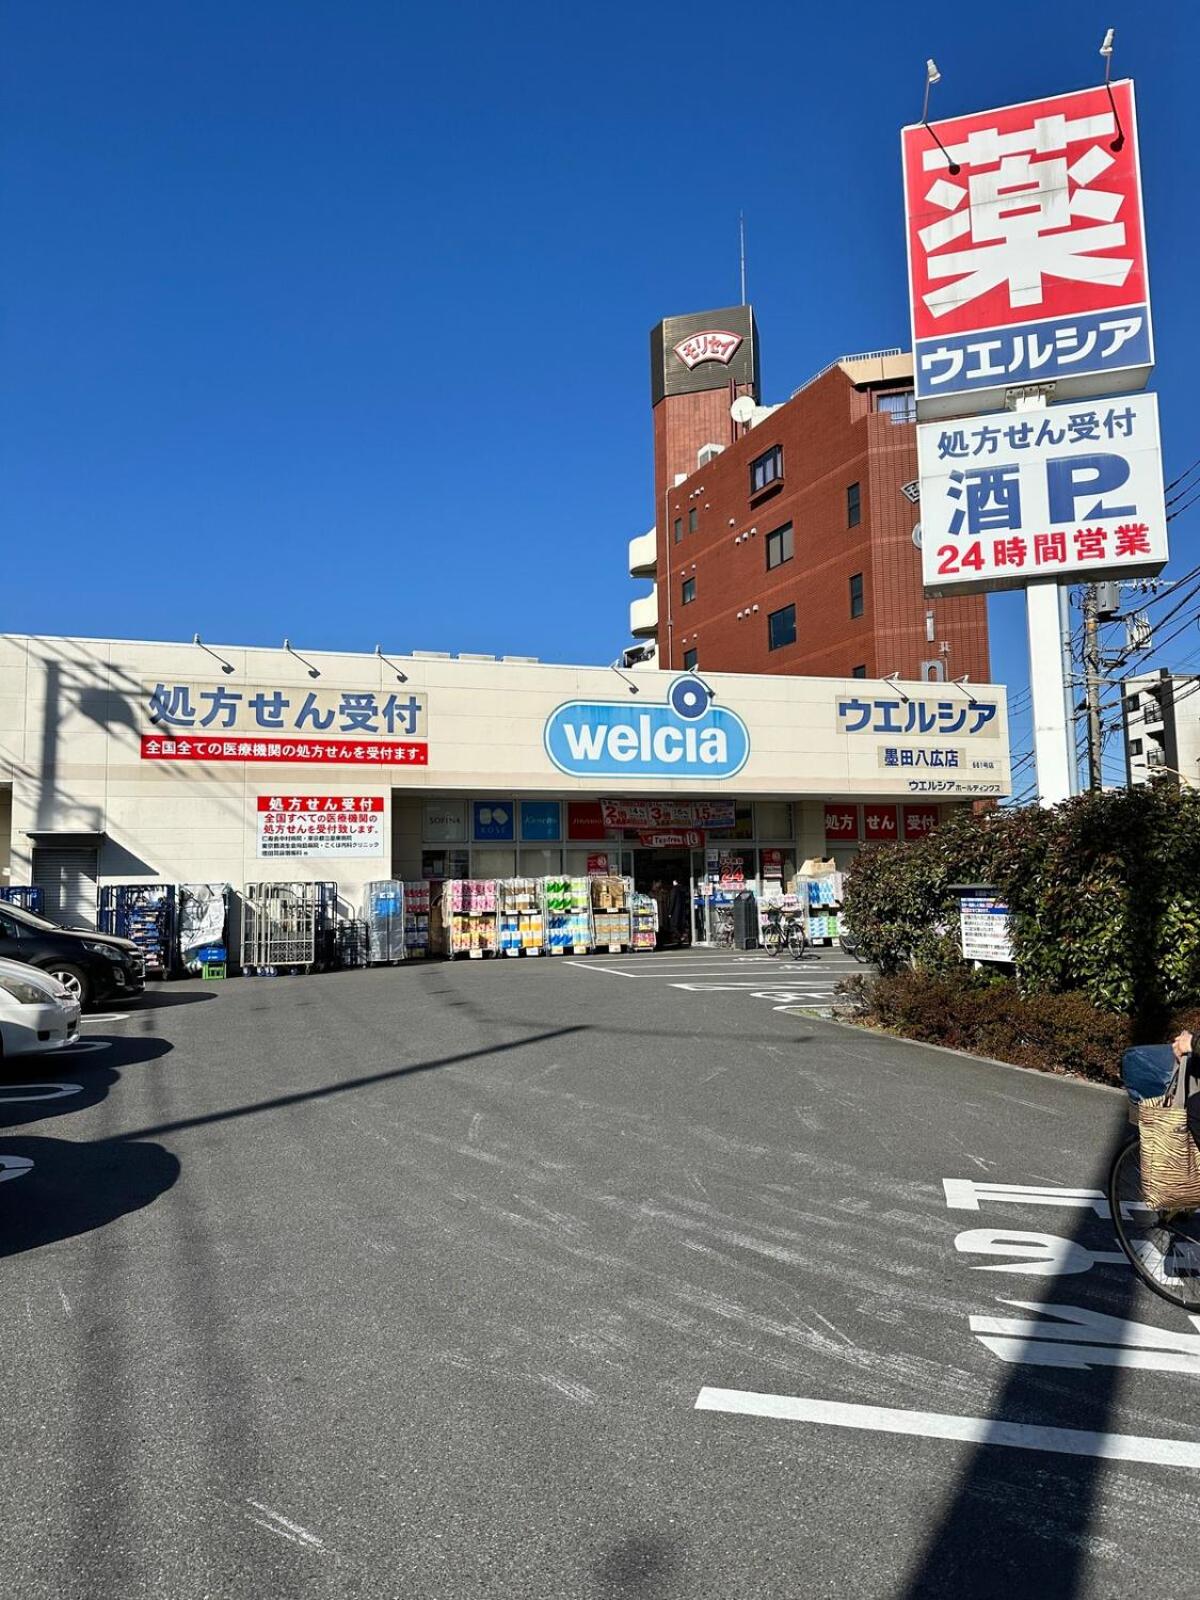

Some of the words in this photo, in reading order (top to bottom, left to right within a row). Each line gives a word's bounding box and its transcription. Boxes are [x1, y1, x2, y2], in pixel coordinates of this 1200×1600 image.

[918, 112, 1134, 318] 薬
[683, 335, 735, 359] モリセイ
[922, 317, 1142, 385] ウエルシア
[937, 407, 1136, 460] 処方せん受付
[947, 463, 1022, 536] 酒
[937, 523, 1151, 574] 24時間営業
[149, 684, 422, 734] 処方せん受付
[838, 699, 996, 734] ウエルシア
[146, 740, 425, 761] 全国全ての医療機関の処方せんを受付ます。
[563, 714, 728, 763] welcia
[885, 748, 959, 767] 墨田八広店
[264, 813, 378, 823] 全国すべての医療機関の
[269, 797, 373, 811] 処方せん受付
[825, 815, 853, 830] 処方
[866, 815, 895, 830] せん
[907, 815, 935, 830] 受付
